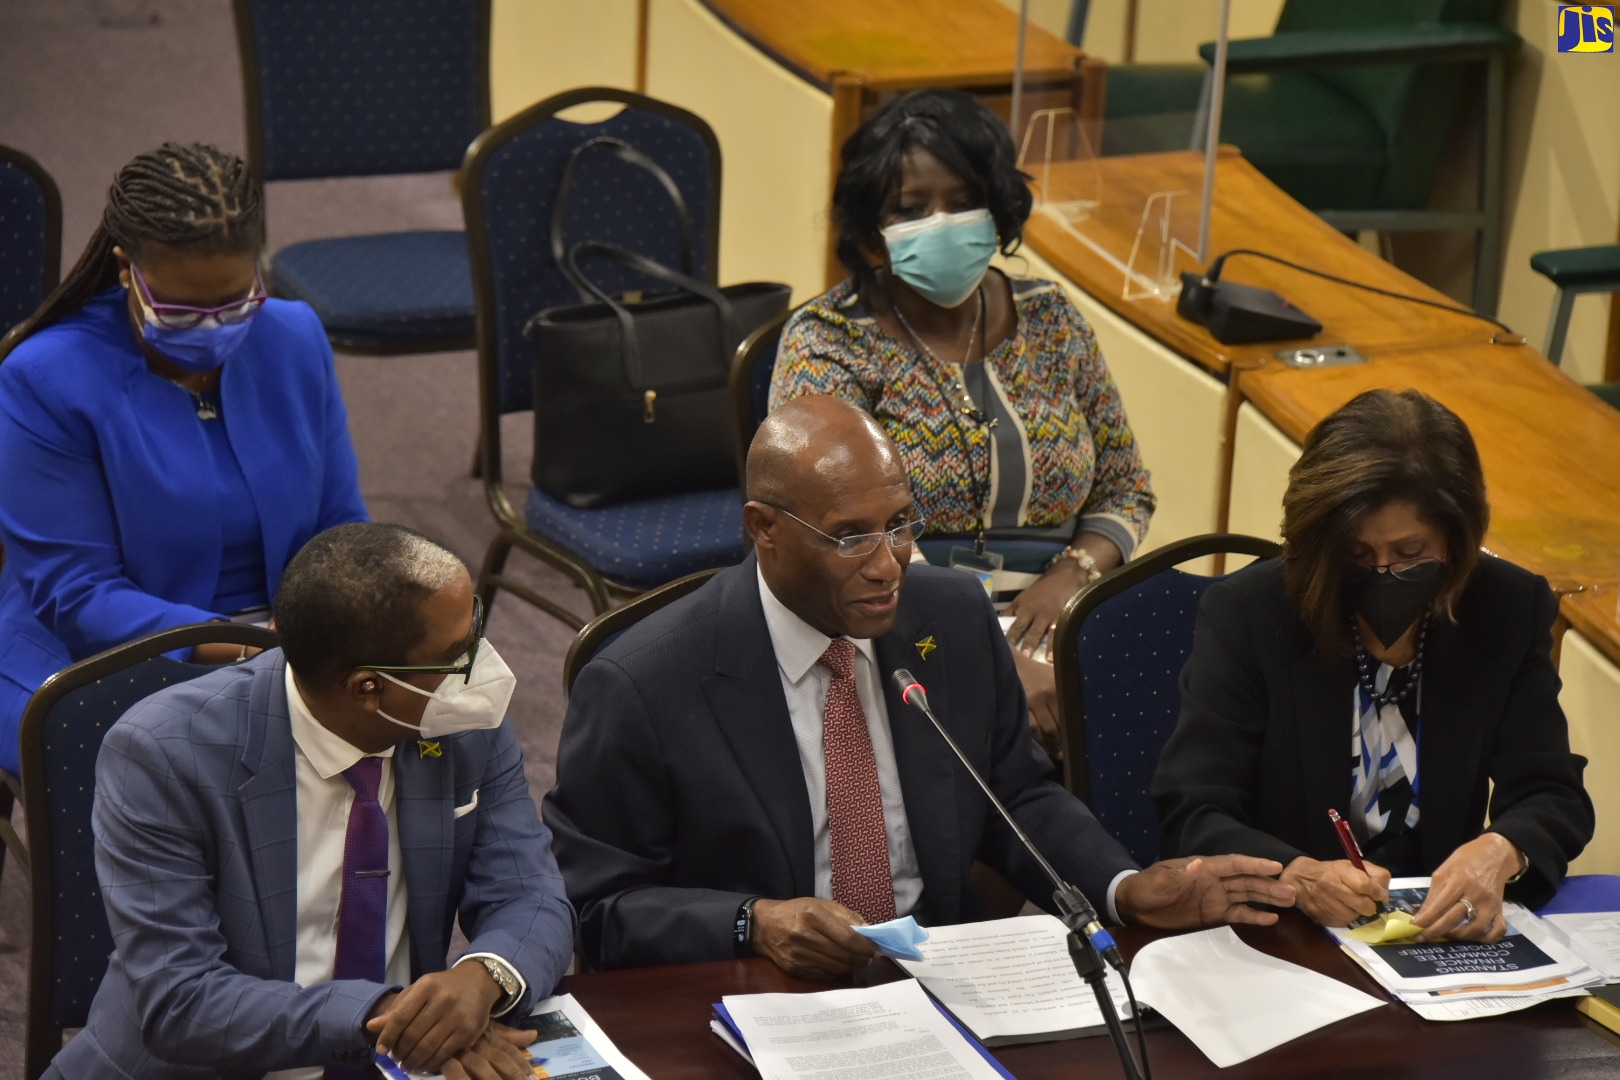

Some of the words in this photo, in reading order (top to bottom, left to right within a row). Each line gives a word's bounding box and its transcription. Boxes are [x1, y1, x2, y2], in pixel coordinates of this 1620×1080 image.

[1397, 947, 1444, 956] BRIEF
[1449, 942, 1514, 952] BUDGET
[1413, 949, 1510, 962] COMMITTEE
[1434, 957, 1505, 967] FINANCE
[1435, 963, 1519, 974] STANDING
